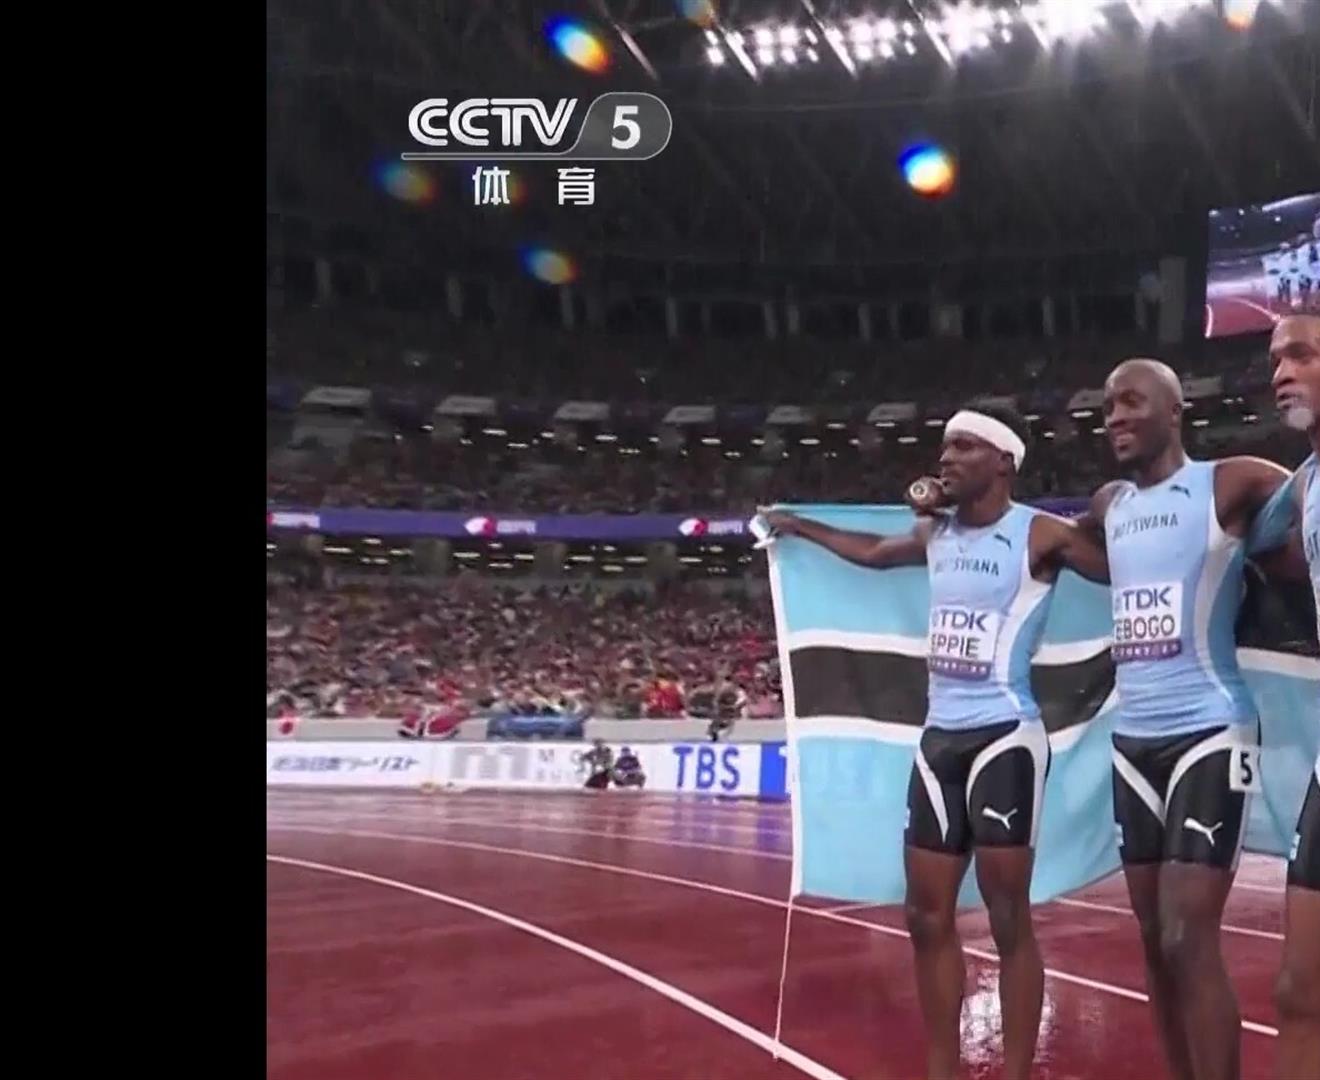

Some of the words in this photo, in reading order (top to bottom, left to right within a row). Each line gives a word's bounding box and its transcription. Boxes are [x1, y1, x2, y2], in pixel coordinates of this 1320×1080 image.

[1113, 511, 1179, 541] TSWANA
[935, 556, 1000, 577] SWANA
[1122, 585, 1173, 611] TDK
[940, 609, 988, 632] TDK
[672, 746, 740, 790] TBS
[1240, 752, 1252, 785] 5
